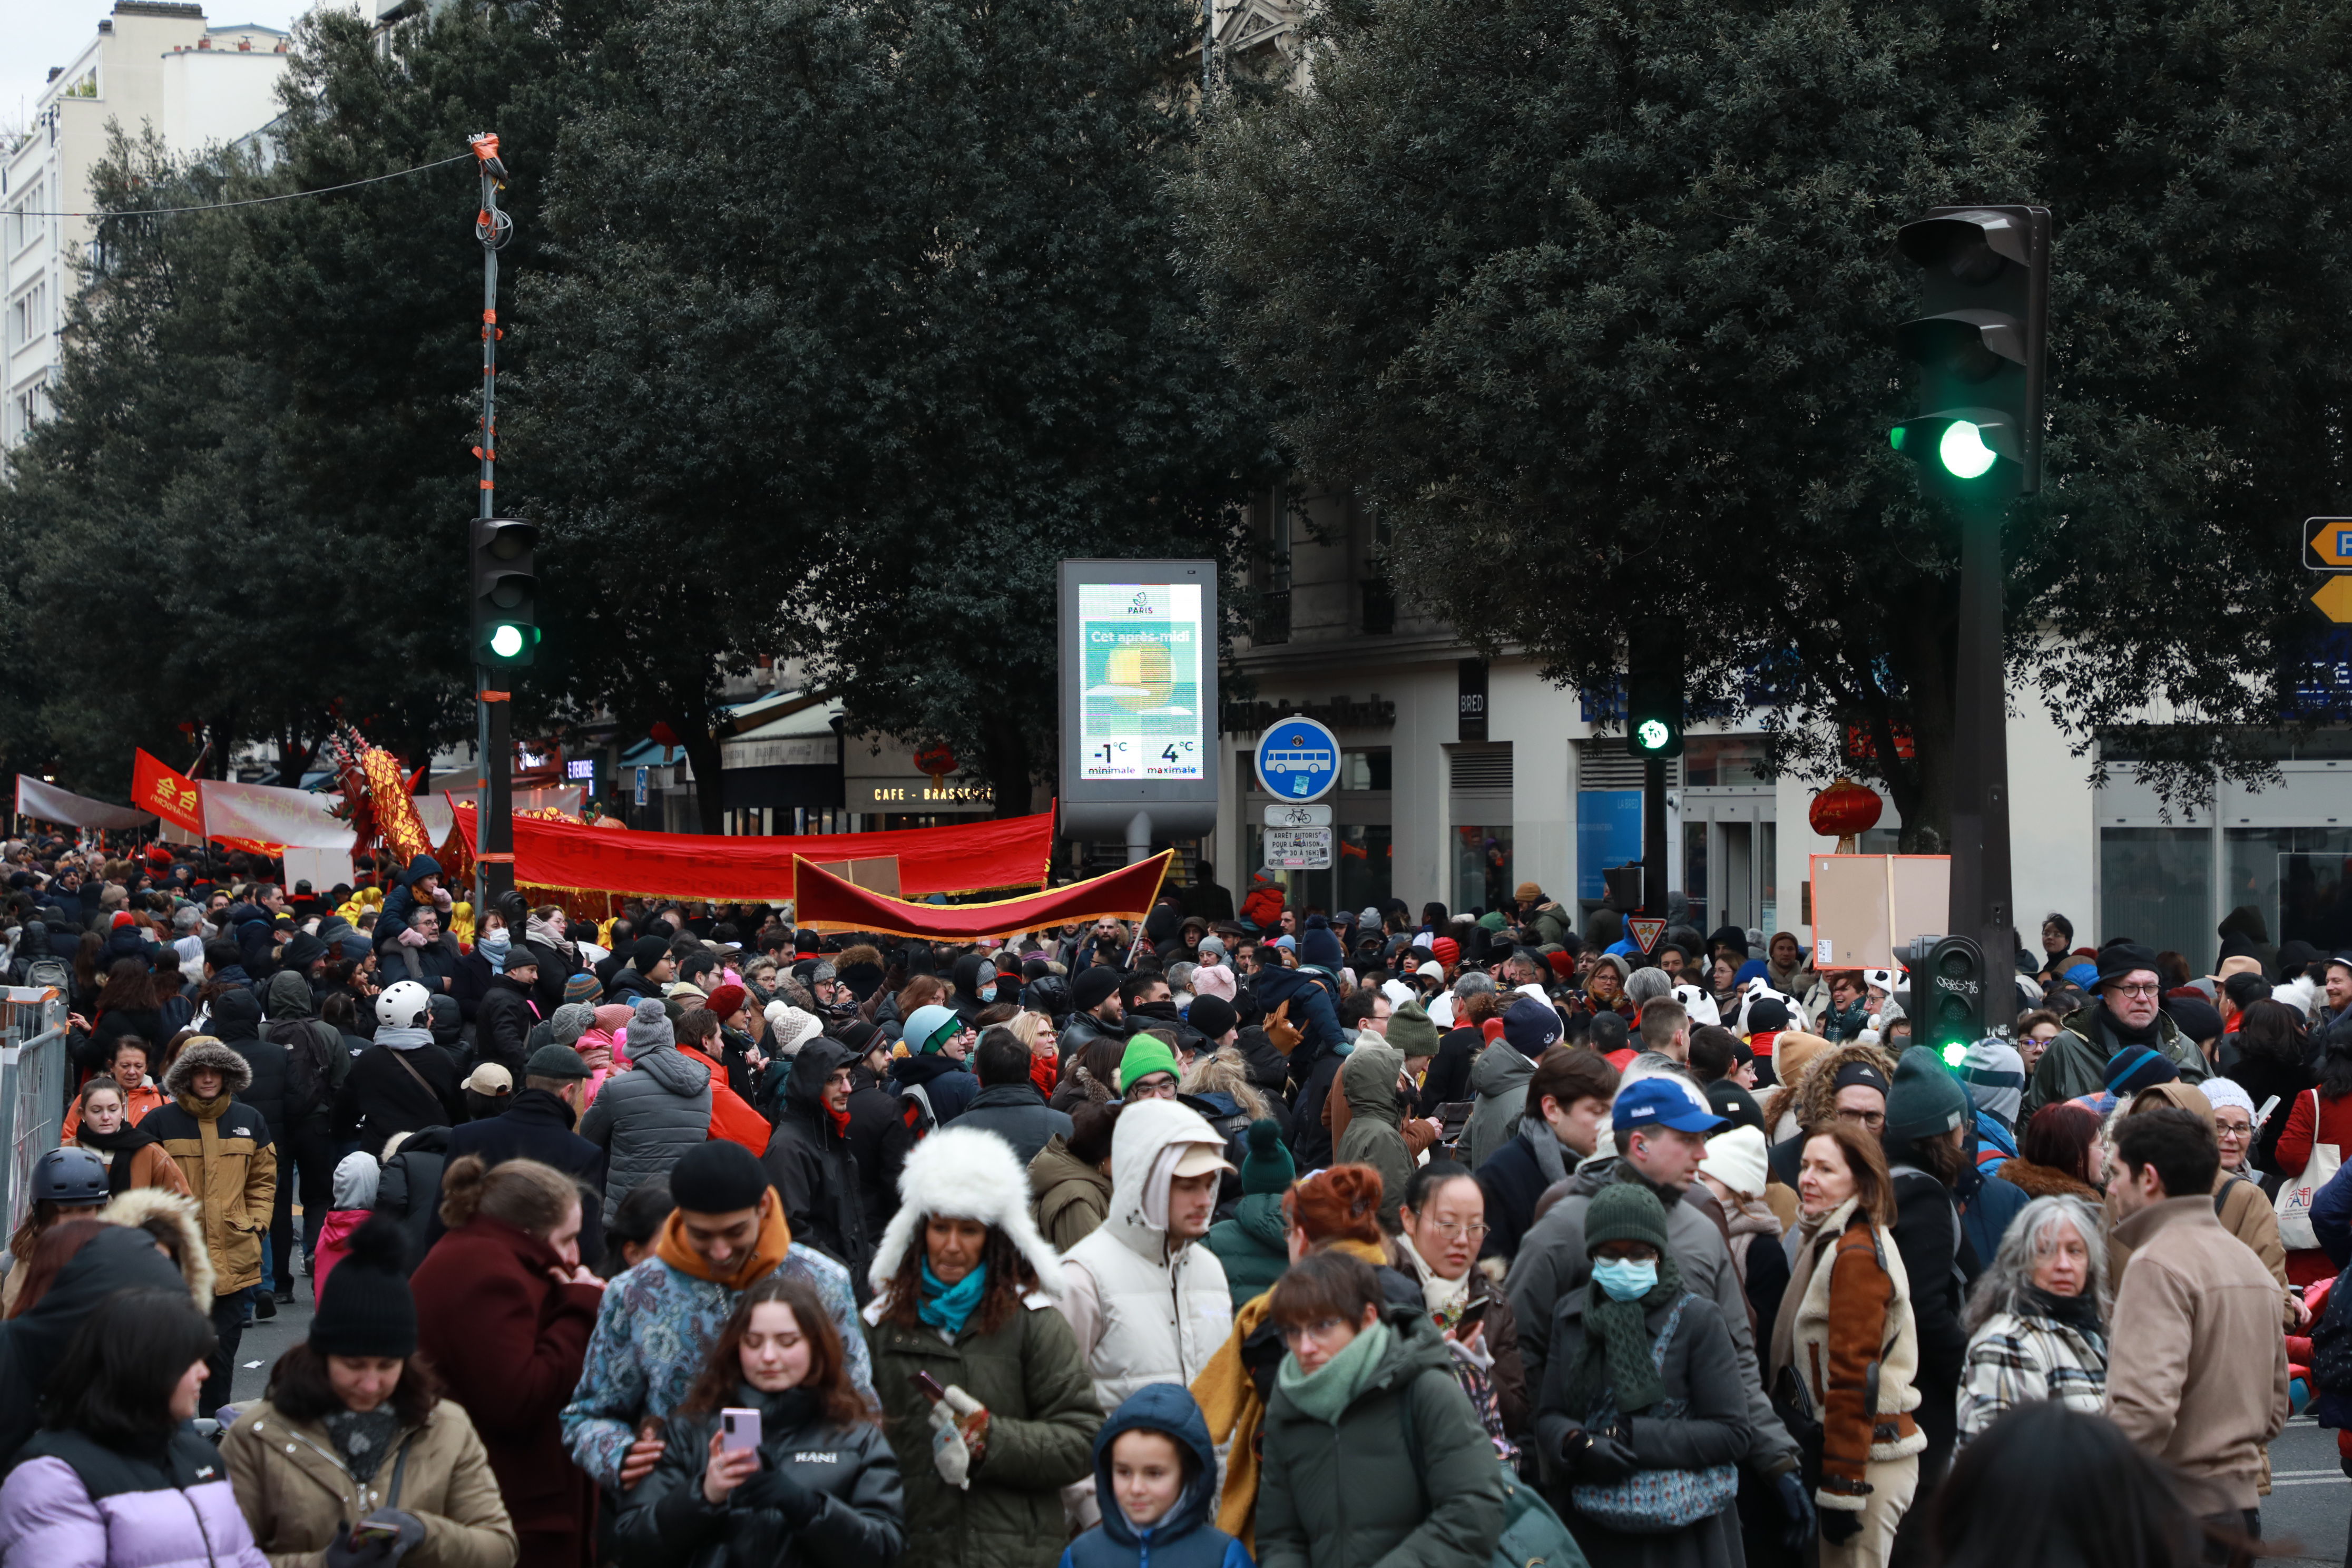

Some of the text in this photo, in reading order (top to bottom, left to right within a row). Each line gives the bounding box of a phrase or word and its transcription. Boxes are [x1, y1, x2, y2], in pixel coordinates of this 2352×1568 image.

[1091, 631, 1190, 645] Cet après-midi
[1461, 694, 1483, 712] BRED
[1089, 766, 1197, 775] minimale maximale
[875, 788, 904, 800] CAFE
[795, 1452, 838, 1463] KANI
